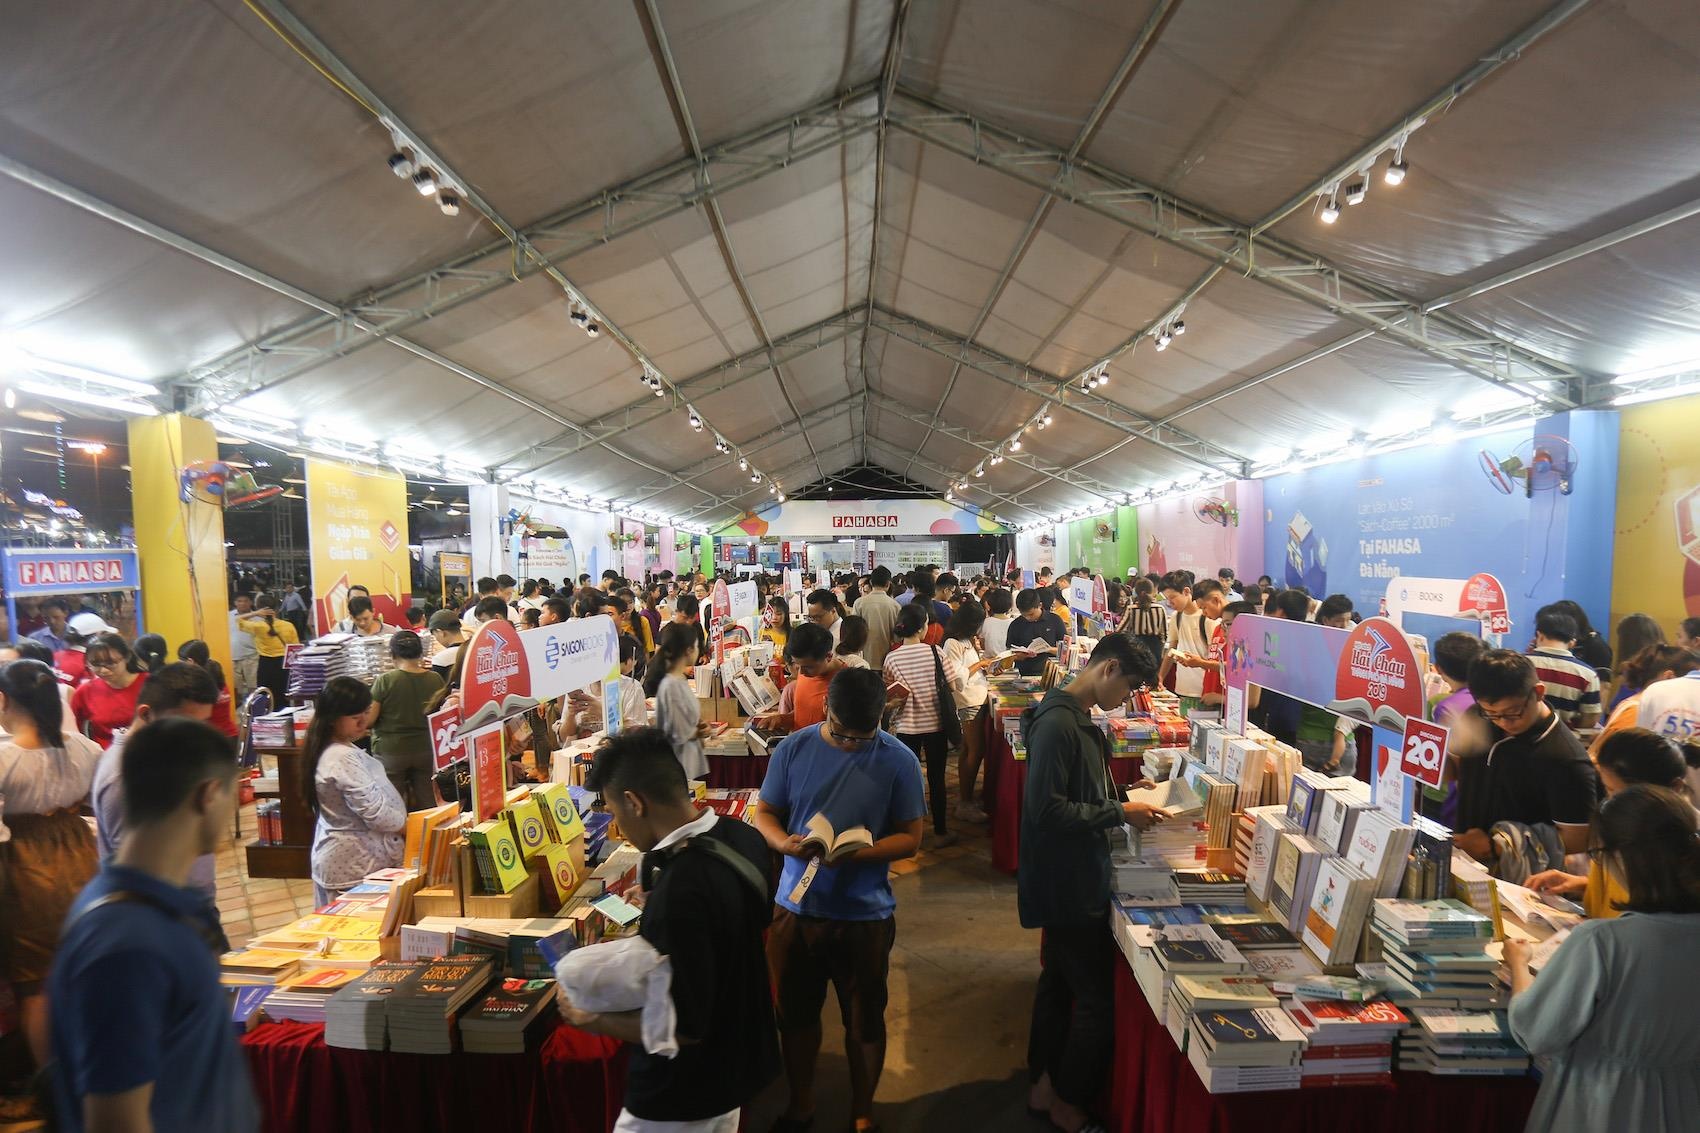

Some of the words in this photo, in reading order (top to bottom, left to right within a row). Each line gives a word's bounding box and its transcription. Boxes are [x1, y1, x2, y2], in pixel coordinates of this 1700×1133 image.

[834, 516, 898, 527] FAHASA
[1412, 514, 1439, 530] 2000
[1359, 540, 1374, 558] Tại
[1375, 538, 1422, 555] FAHASA
[21, 561, 122, 584] FAHASA
[1360, 562, 1373, 578] Đà
[1419, 591, 1444, 602] BOOKS
[1374, 654, 1406, 677] Châu
[1366, 682, 1388, 701] 2019
[1663, 714, 1694, 737] 55
[1420, 730, 1443, 742] DISCOUNT
